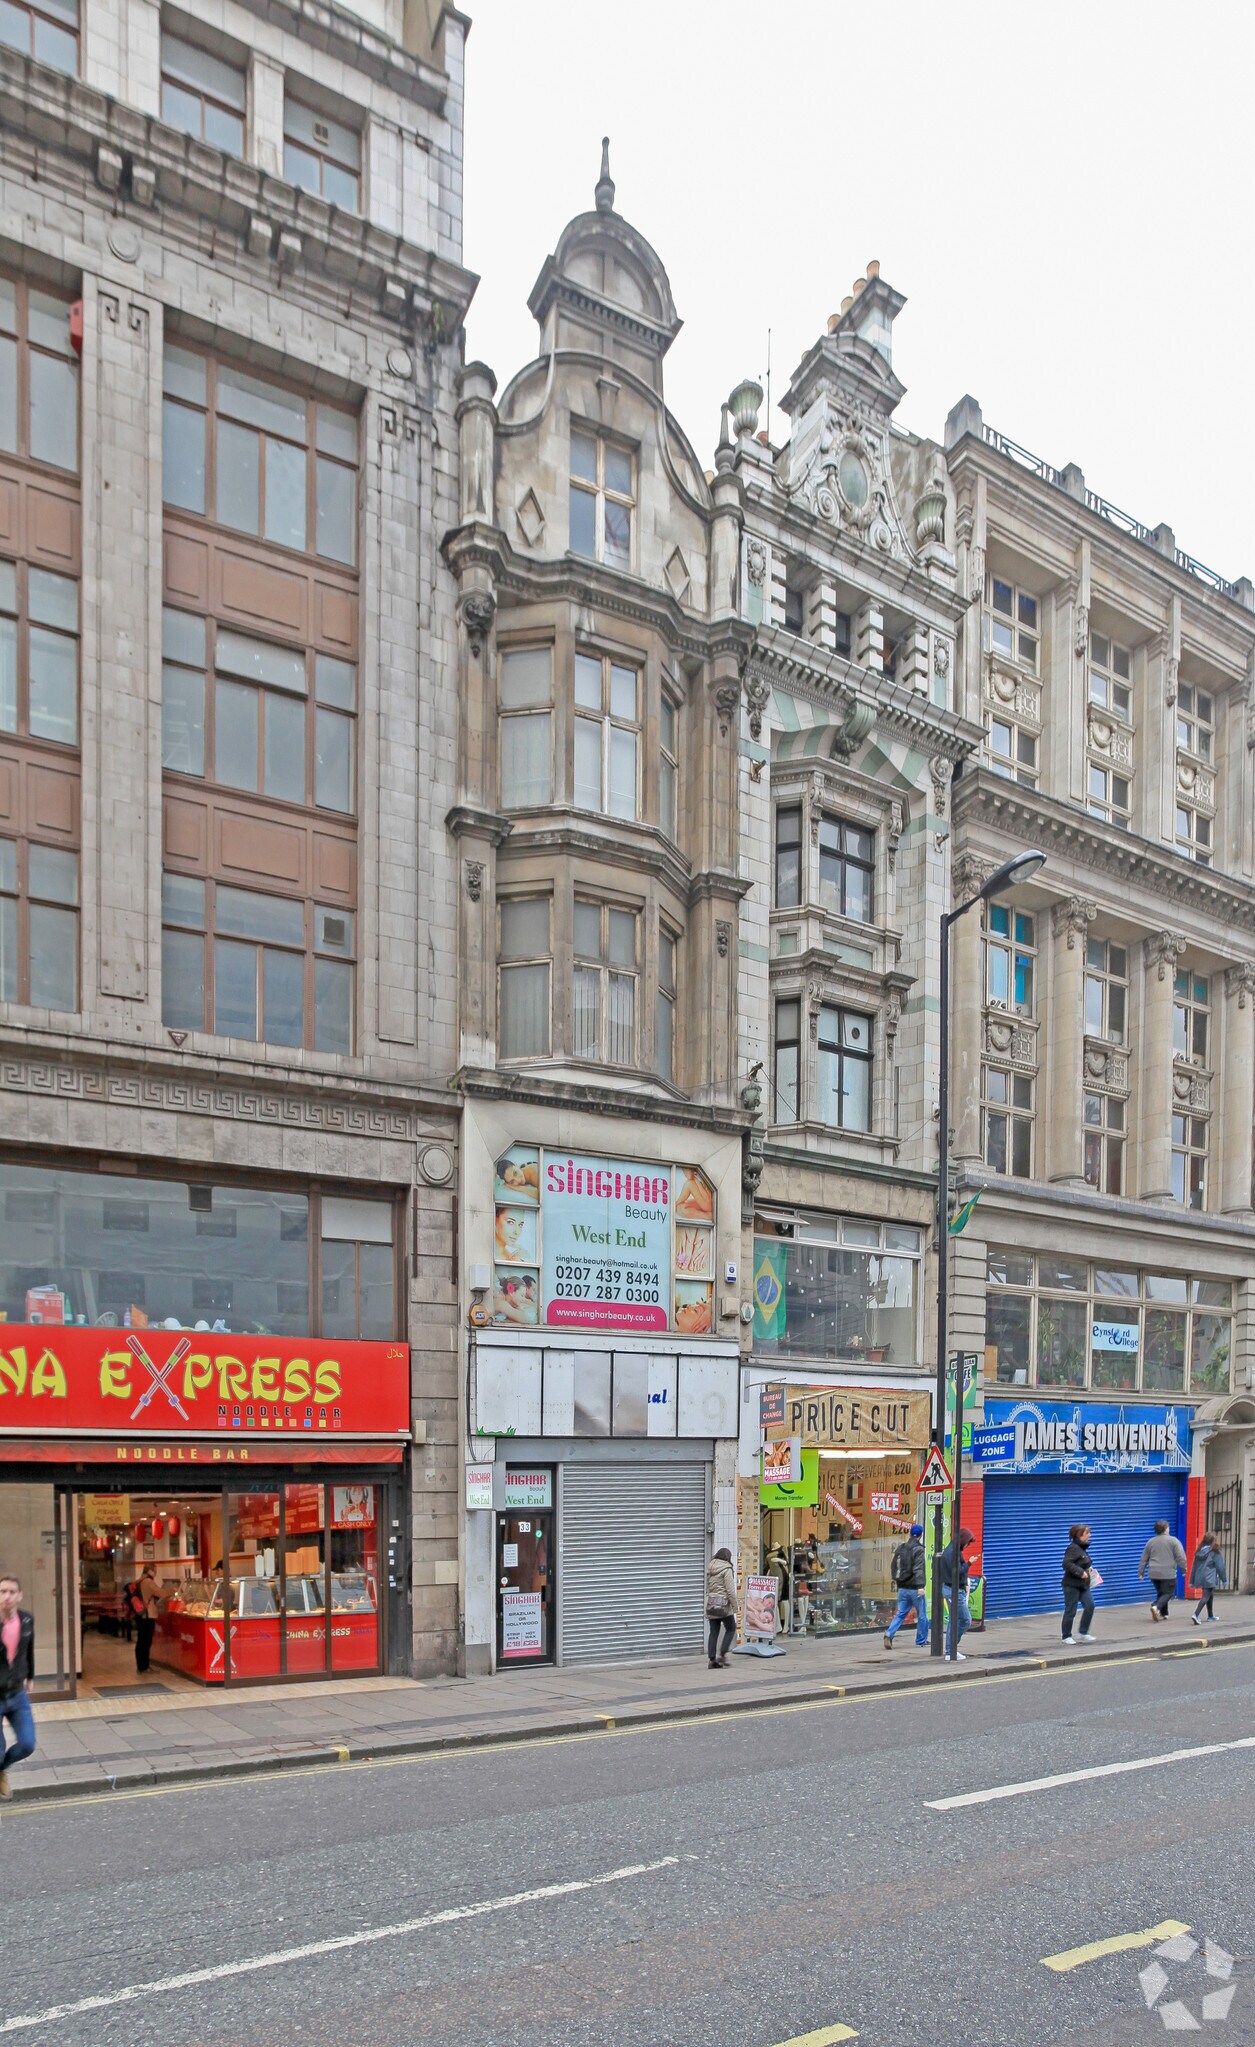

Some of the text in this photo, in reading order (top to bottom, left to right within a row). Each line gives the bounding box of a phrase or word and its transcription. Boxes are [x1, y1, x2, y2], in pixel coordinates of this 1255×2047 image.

[625, 1205, 667, 1224] Beauty
[572, 1224, 646, 1248] West End
[555, 1254, 658, 1270] singhar.beauty@hotmail.co.uk
[556, 1265, 660, 1287] 0207 439 8494
[556, 1282, 660, 1303] 0207 287 0300
[556, 1308, 656, 1323] www.singharbeauty.co.uk
[99, 1335, 342, 1420] EXPRESS
[763, 1393, 782, 1402] BUREAU
[218, 1405, 341, 1418] NOODLE BAR
[763, 1411, 782, 1419] CHANGE
[792, 1402, 909, 1433] PRICE CUT
[974, 1432, 1015, 1445] LUGGAGE
[1083, 1424, 1176, 1451] SOUVENIRS
[117, 1447, 249, 1460] NOODLE BAR
[982, 1446, 1006, 1457] ZONE
[764, 1467, 791, 1477] MASSAGE
[895, 1463, 911, 1476] £20
[481, 1494, 490, 1505] End
[505, 1495, 545, 1505] West End
[871, 1497, 899, 1511] SALE
[520, 1523, 530, 1531] 33
[753, 1578, 776, 1586] MASSAGE
